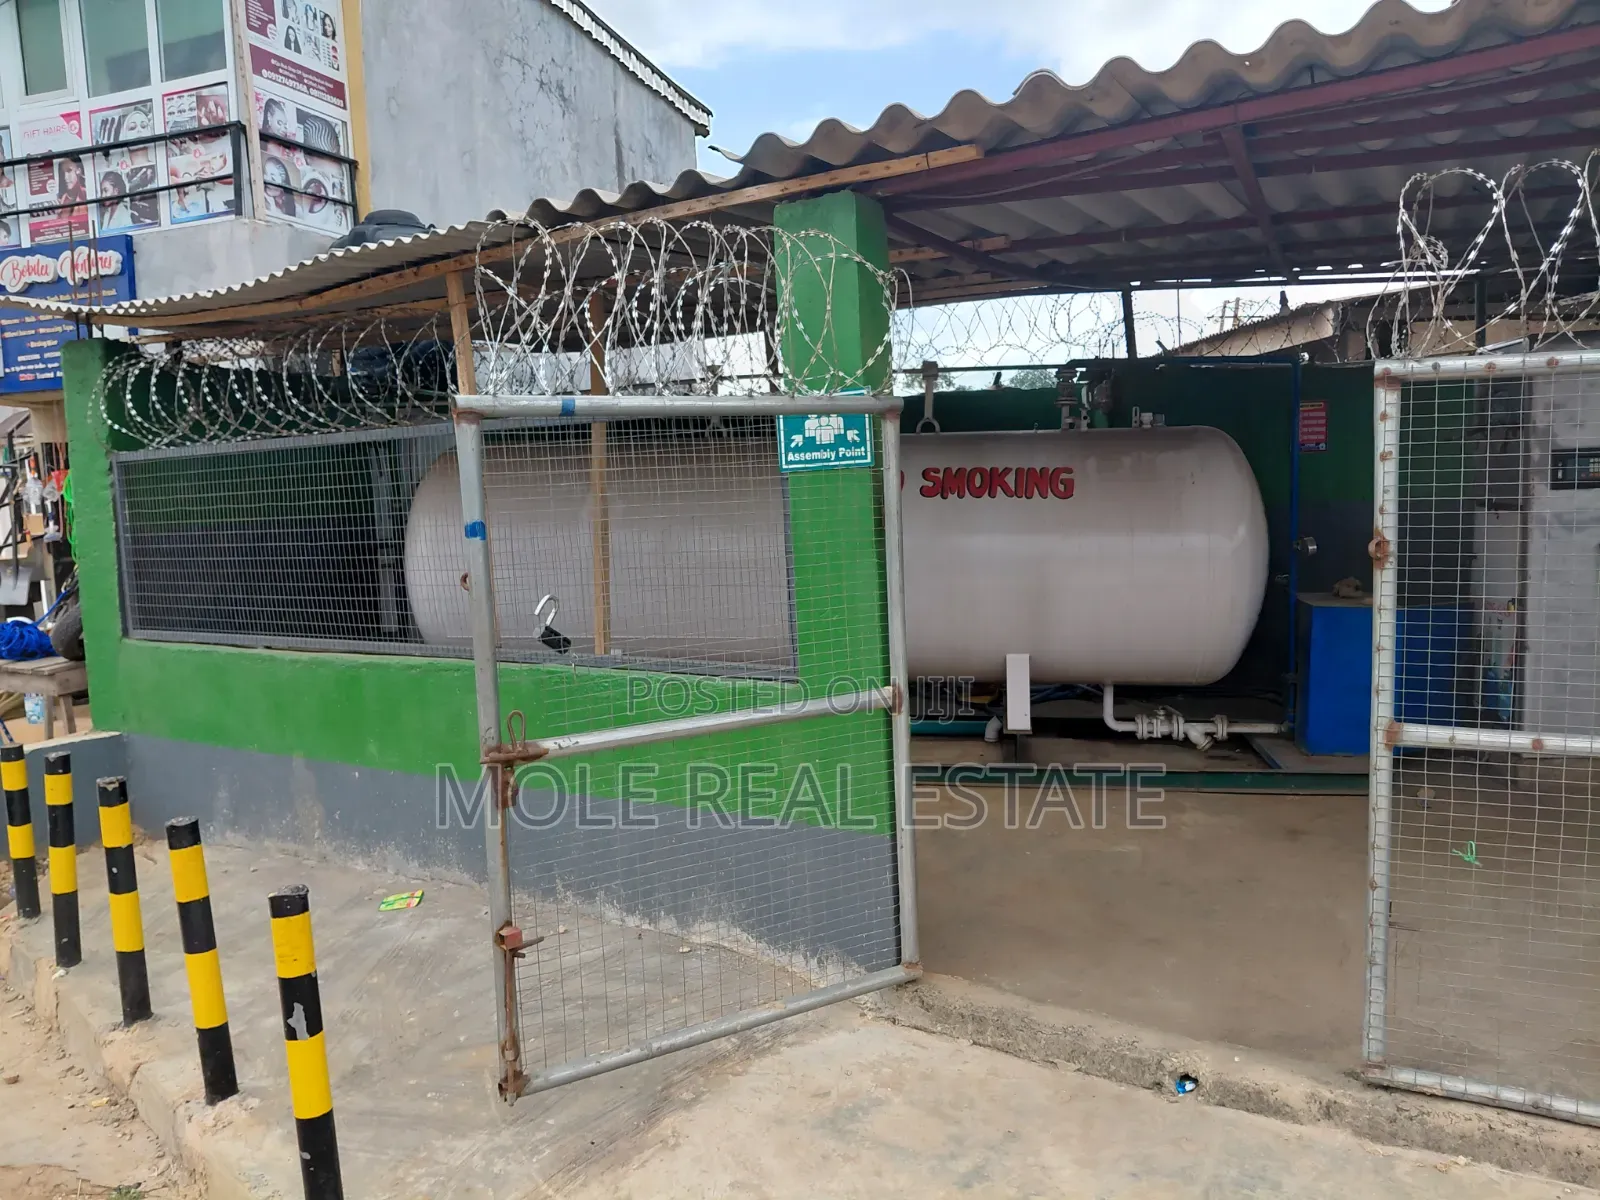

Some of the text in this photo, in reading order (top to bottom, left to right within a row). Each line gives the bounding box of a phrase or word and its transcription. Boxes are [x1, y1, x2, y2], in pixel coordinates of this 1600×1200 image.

[787, 446, 866, 461] Assembly Point
[919, 466, 1075, 500] SMOKING
